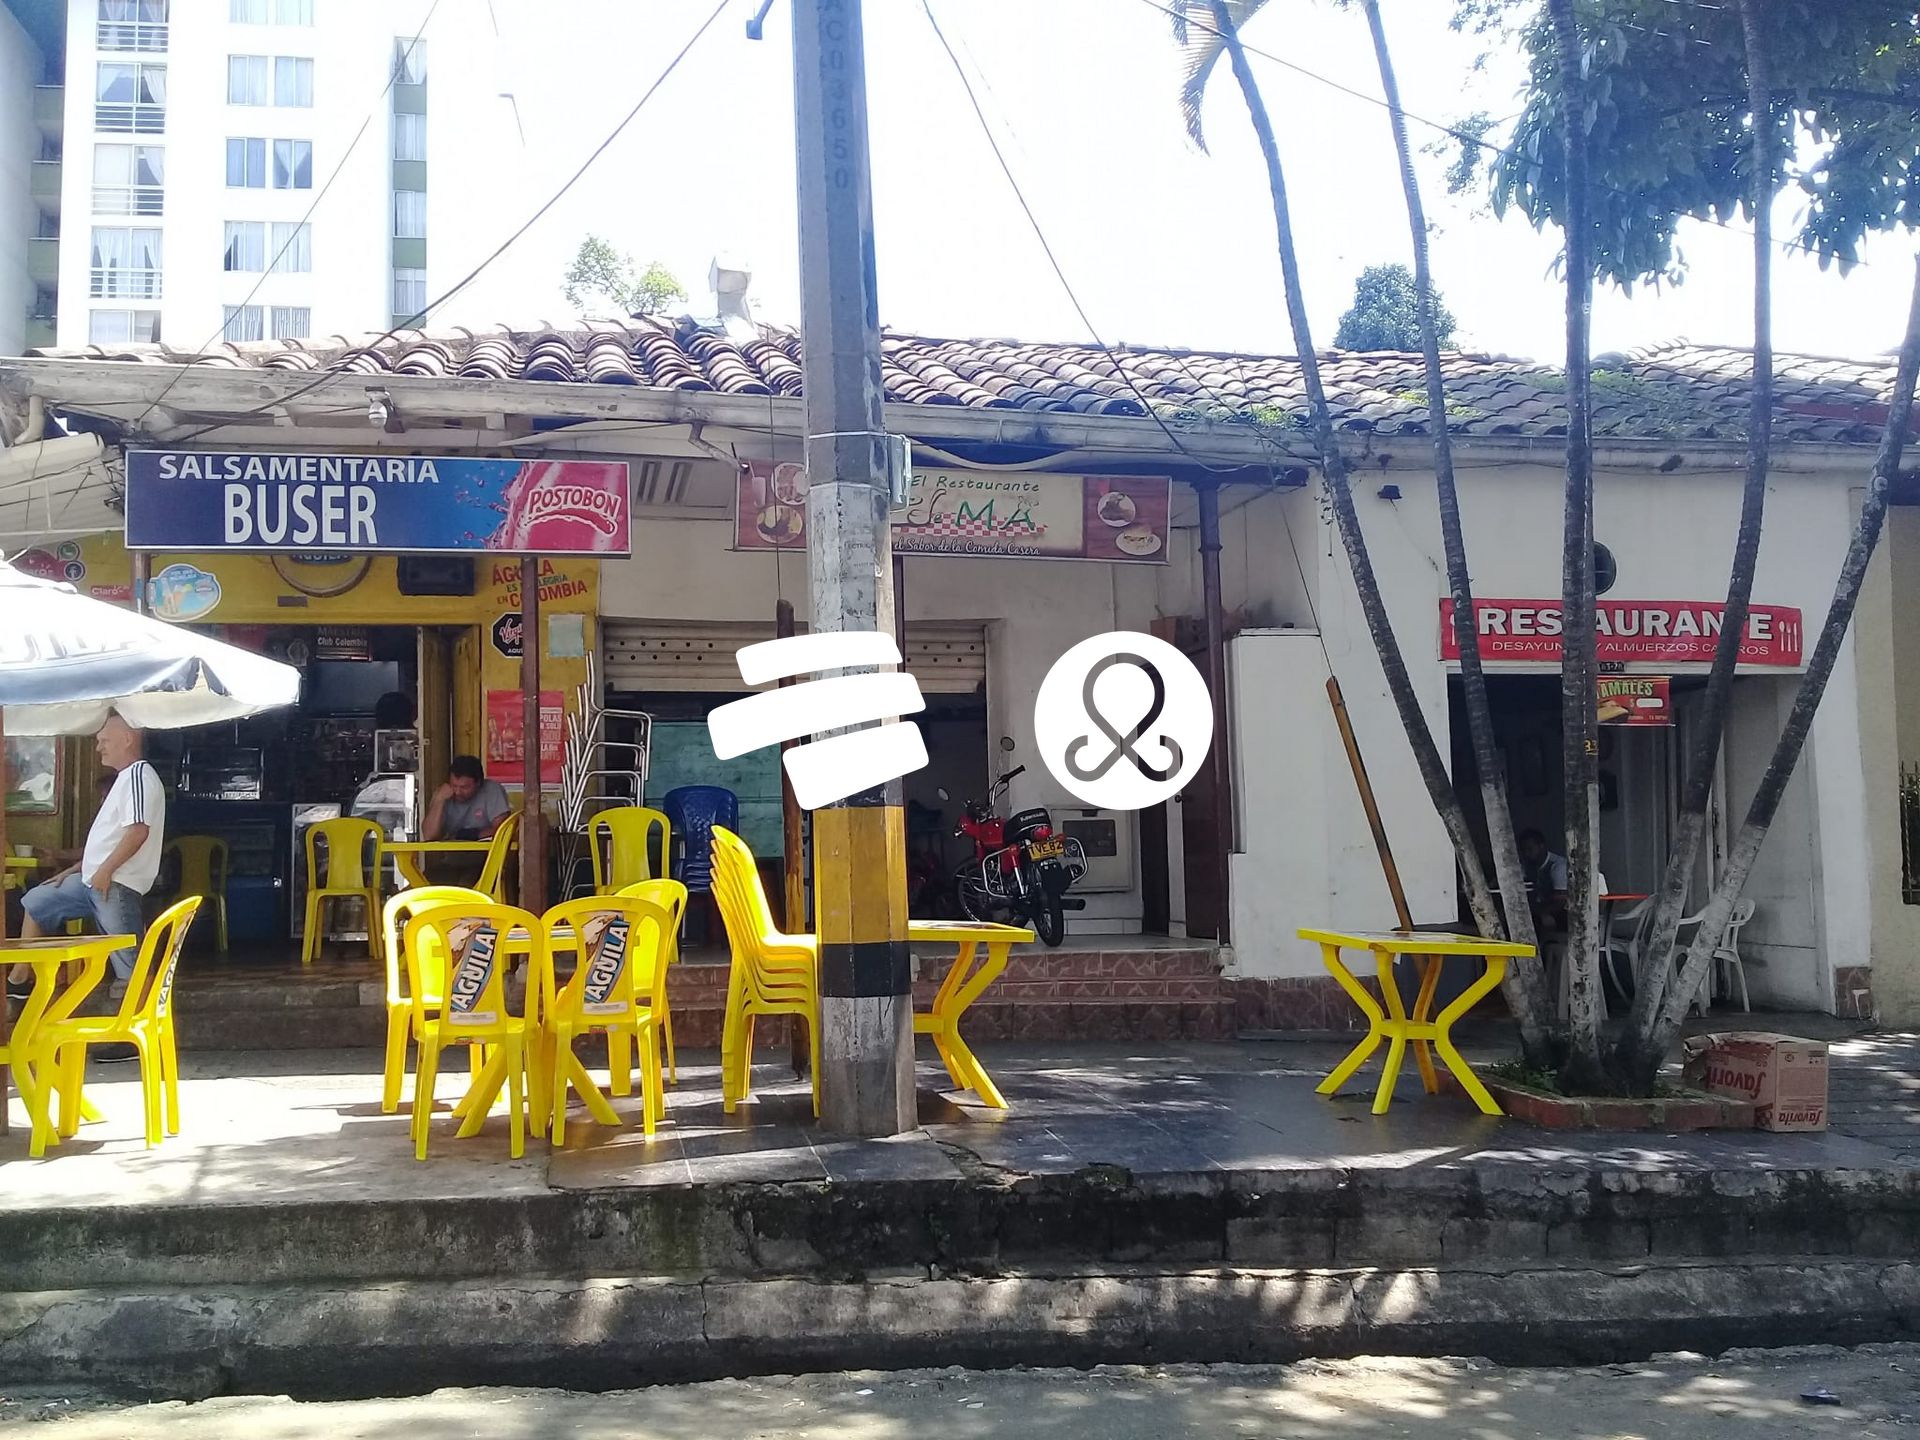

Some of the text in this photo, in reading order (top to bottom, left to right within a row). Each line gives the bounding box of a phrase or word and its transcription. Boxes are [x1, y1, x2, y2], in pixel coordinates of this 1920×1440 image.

[159, 454, 439, 483] SALSAMENTARIA
[911, 475, 1040, 492] El Restaurante
[224, 483, 378, 544] BUSER
[528, 487, 620, 519] POSTOBON
[907, 538, 935, 551] Sabor
[937, 539, 951, 551] de
[951, 538, 962, 552] la
[966, 541, 1005, 553] Comida
[1007, 543, 1041, 555] Casera
[510, 580, 588, 608] COMBIA
[1478, 608, 1773, 641] RESAURANE
[1492, 641, 1563, 651] DESAYUN
[1604, 642, 1699, 652] ALMUERZOS
[1702, 643, 1769, 655] CAROS
[451, 932, 496, 1009] AGUILA
[585, 926, 629, 1001] AGUILA
